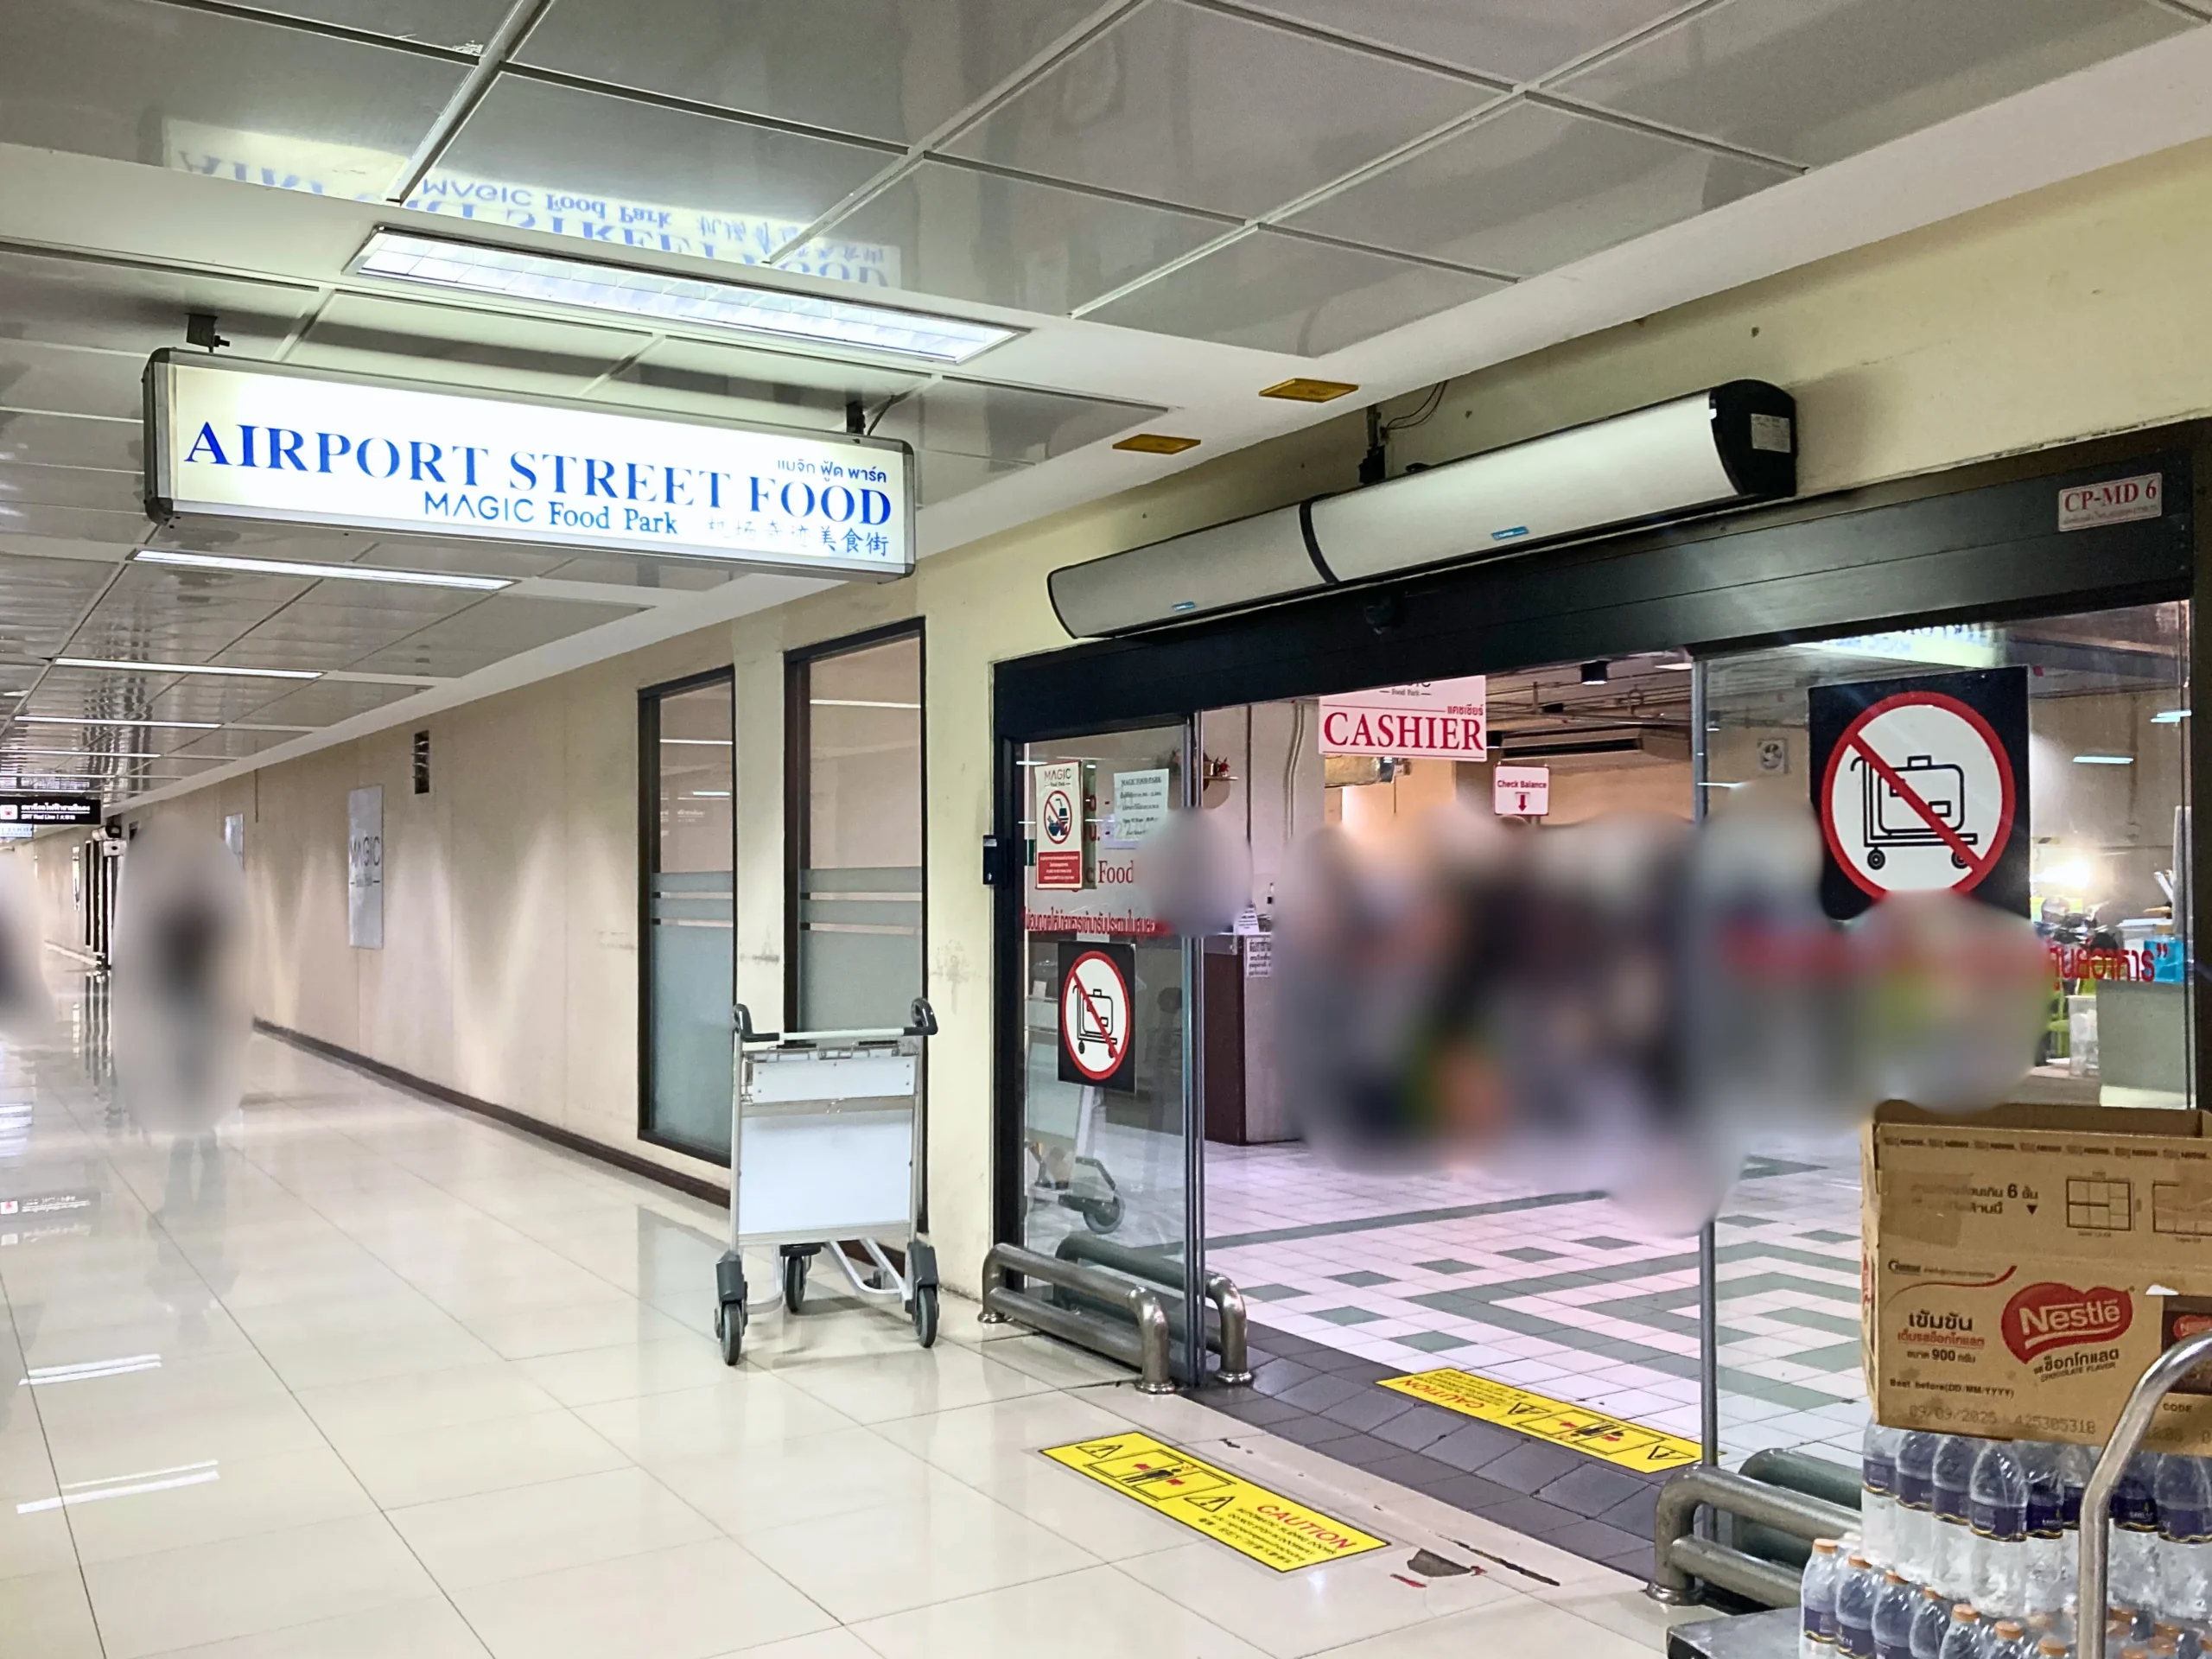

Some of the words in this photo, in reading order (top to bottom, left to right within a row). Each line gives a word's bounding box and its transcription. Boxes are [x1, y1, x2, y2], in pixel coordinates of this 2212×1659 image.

[184, 422, 489, 486] AIRPORT
[509, 451, 731, 509] STREET
[749, 475, 891, 526] FOOD
[848, 466, 887, 483] พาร์ค
[2064, 483, 2139, 512] CP-MD
[2145, 480, 2157, 499] 6
[424, 491, 534, 523] MAGIC
[548, 500, 611, 531] Food
[623, 507, 679, 535] Park
[1324, 712, 1484, 751] CASHIER
[1044, 768, 1071, 780] MAGIC
[1497, 779, 1518, 788] Check
[1521, 780, 1547, 789] Balance
[1098, 860, 1134, 884] Food
[2006, 1183, 2018, 1198] 6
[2019, 1298, 2120, 1336] Nestlé
[1932, 1349, 1955, 1362] 900
[1889, 1378, 1911, 1389] Best
[2163, 1402, 2192, 1413] CODE
[1256, 1504, 1358, 1549] CAUTION
